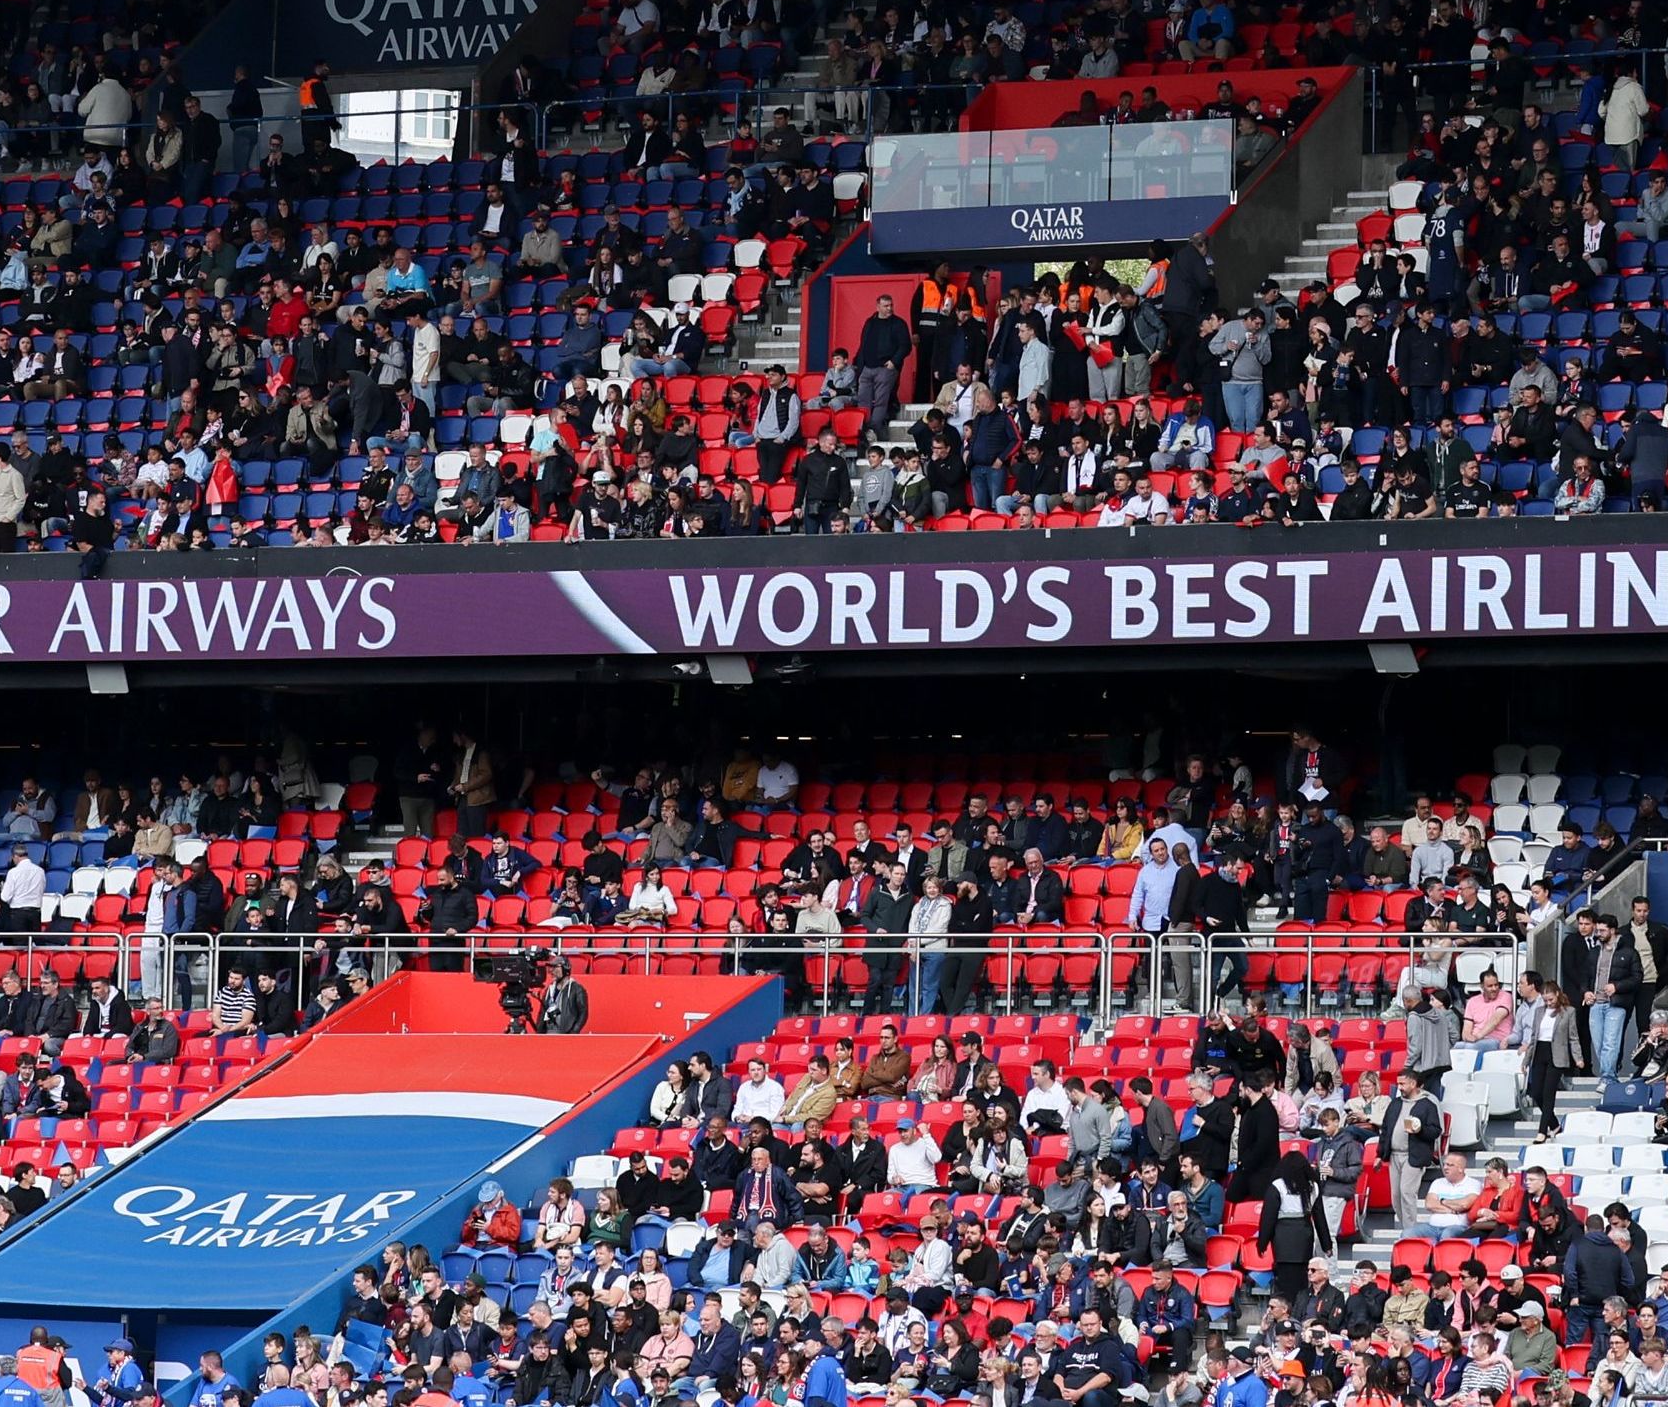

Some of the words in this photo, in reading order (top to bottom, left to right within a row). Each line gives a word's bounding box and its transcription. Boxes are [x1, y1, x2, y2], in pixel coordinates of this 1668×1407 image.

[1011, 207, 1084, 232] QATAR
[1430, 219, 1445, 238] 78
[1029, 227, 1084, 242] AIRWAYS
[48, 576, 397, 653] AIRWAYS
[668, 566, 1072, 647] WORLD'S
[1104, 560, 1329, 640] BEST
[113, 1185, 416, 1226] QATAR
[143, 1223, 380, 1248] AIRWAYS
